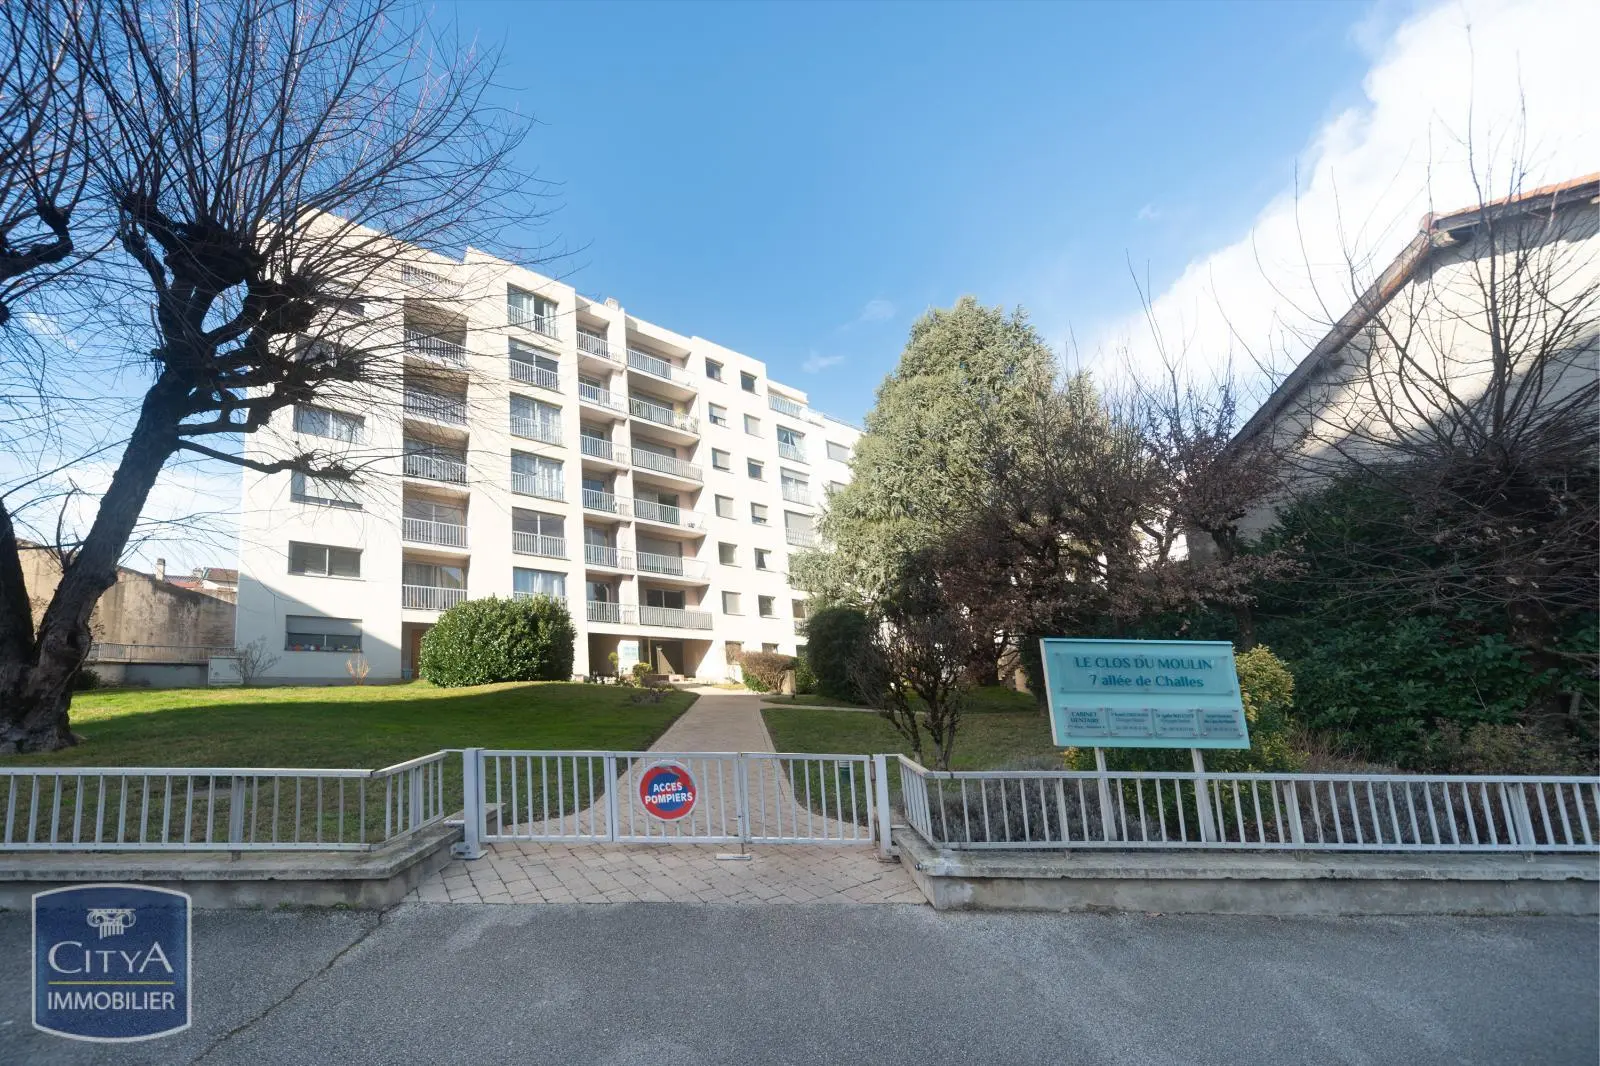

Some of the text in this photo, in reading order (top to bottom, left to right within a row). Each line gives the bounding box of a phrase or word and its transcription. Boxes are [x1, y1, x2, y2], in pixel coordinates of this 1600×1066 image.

[1074, 656, 1213, 670] LE CLOS DU MOULIN
[1089, 674, 1205, 688] 7 allée de Challes
[653, 781, 683, 793] ACCES
[644, 791, 693, 805] POMPIERS
